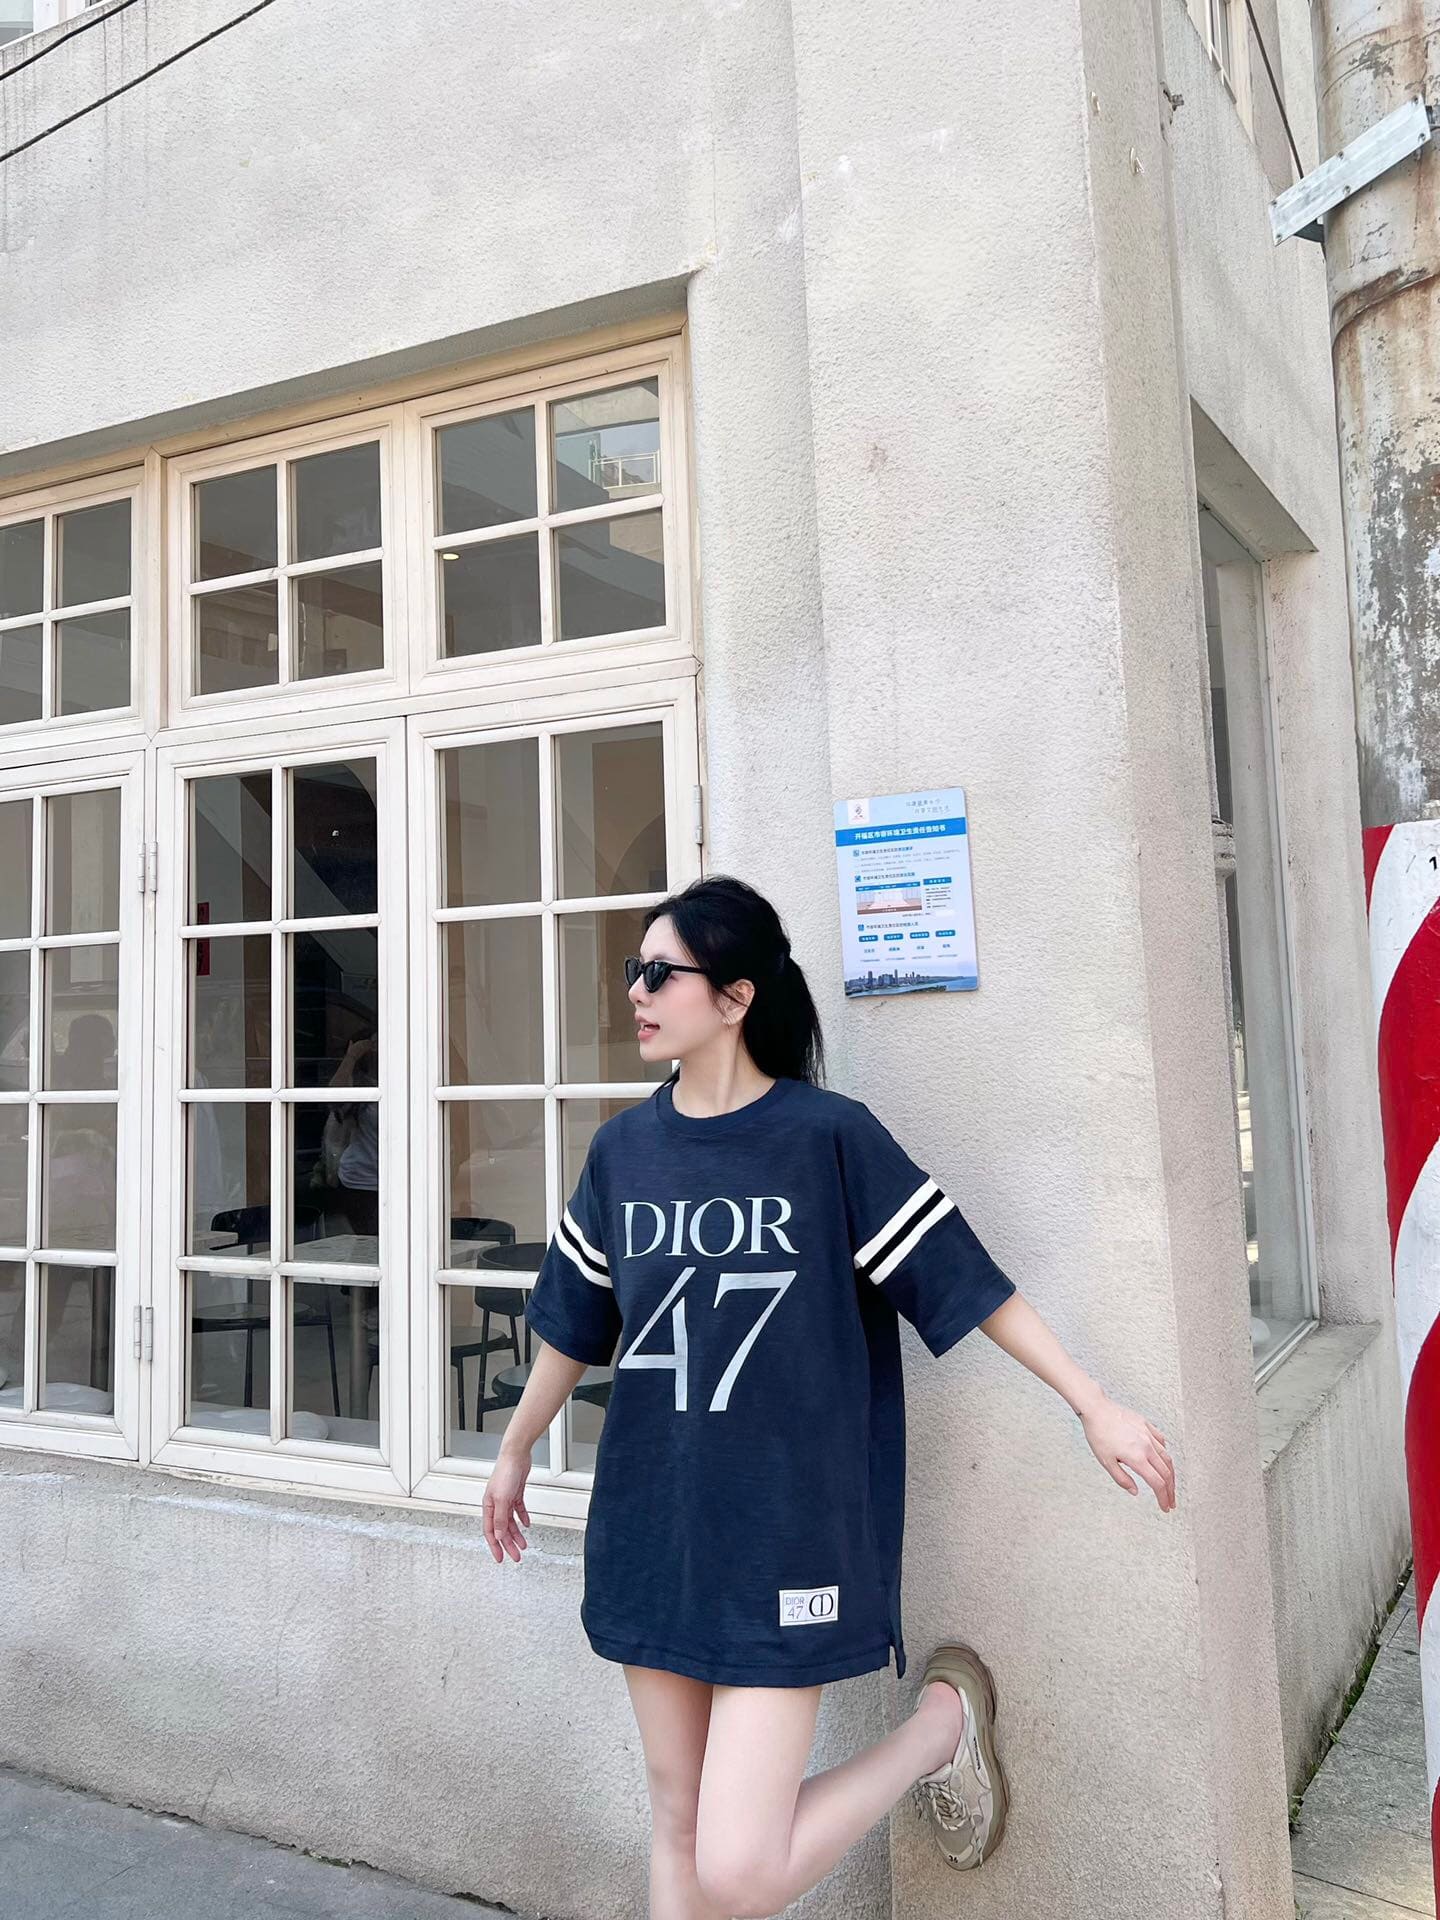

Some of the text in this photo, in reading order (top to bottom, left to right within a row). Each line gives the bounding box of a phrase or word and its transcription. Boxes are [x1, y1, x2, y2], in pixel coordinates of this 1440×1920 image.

[621, 1197, 800, 1258] DIOR
[618, 1266, 797, 1412] 47
[786, 1596, 805, 1606] DIOR
[788, 1606, 804, 1620] 47
